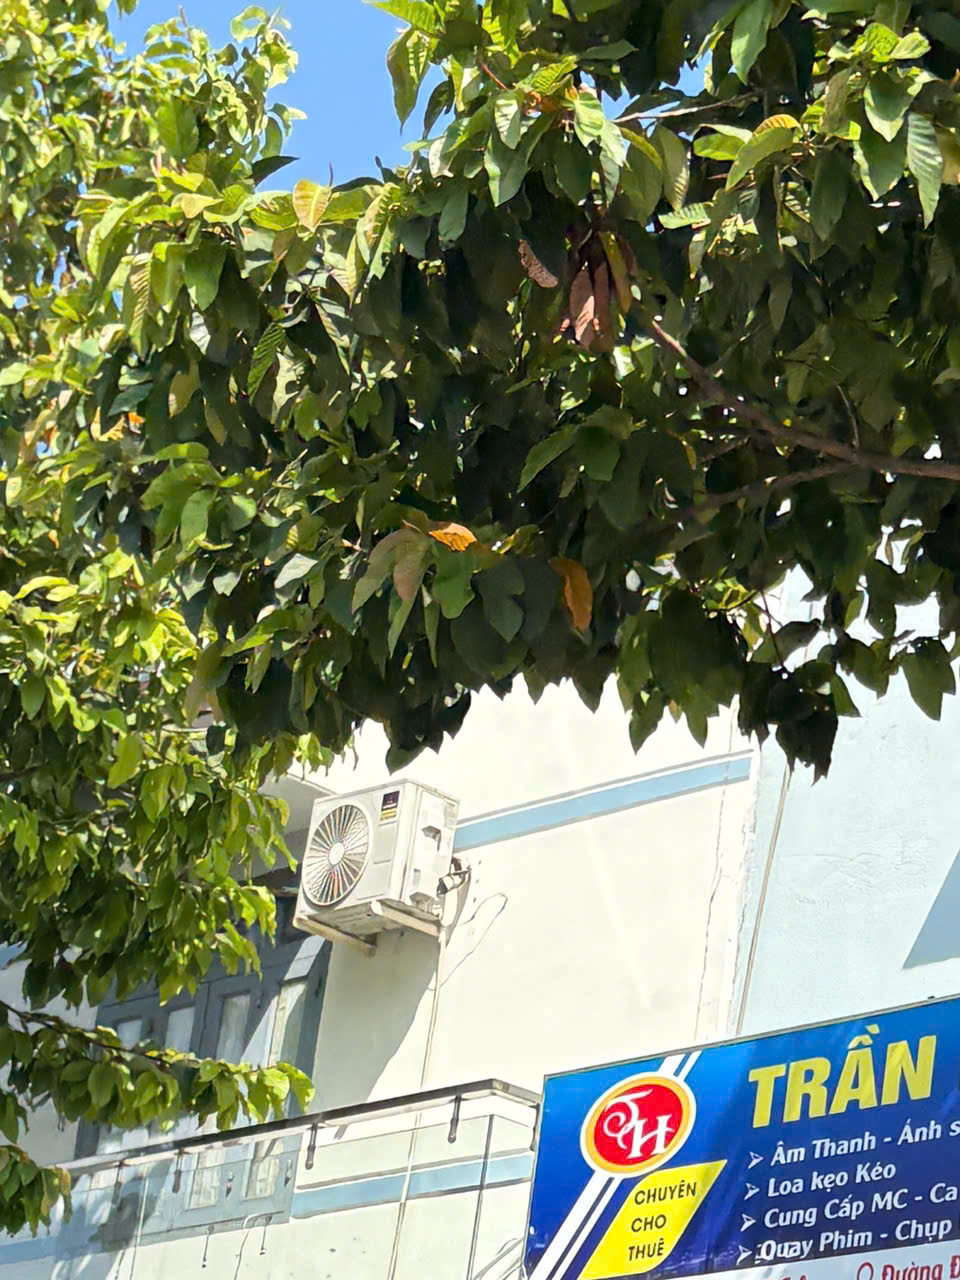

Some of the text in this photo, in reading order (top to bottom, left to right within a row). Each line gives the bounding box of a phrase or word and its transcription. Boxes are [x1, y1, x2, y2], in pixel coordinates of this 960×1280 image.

[748, 1024, 937, 1128] TRẦN
[770, 1140, 806, 1167] Âm
[811, 1131, 877, 1159] Thanh
[897, 1118, 942, 1145] Ánh
[634, 1179, 697, 1206] CHUYÊN
[767, 1161, 896, 1197] Loa kẹo Kéo
[631, 1213, 667, 1233] CHO
[763, 1207, 817, 1229] Cung
[824, 1194, 865, 1220] Cấp
[871, 1188, 909, 1213] MC
[930, 1182, 959, 1204] Ca
[628, 1238, 665, 1262] THUÊ
[758, 1238, 813, 1261] Quay
[819, 1229, 873, 1252] Phim
[895, 1219, 953, 1242] Chụp
